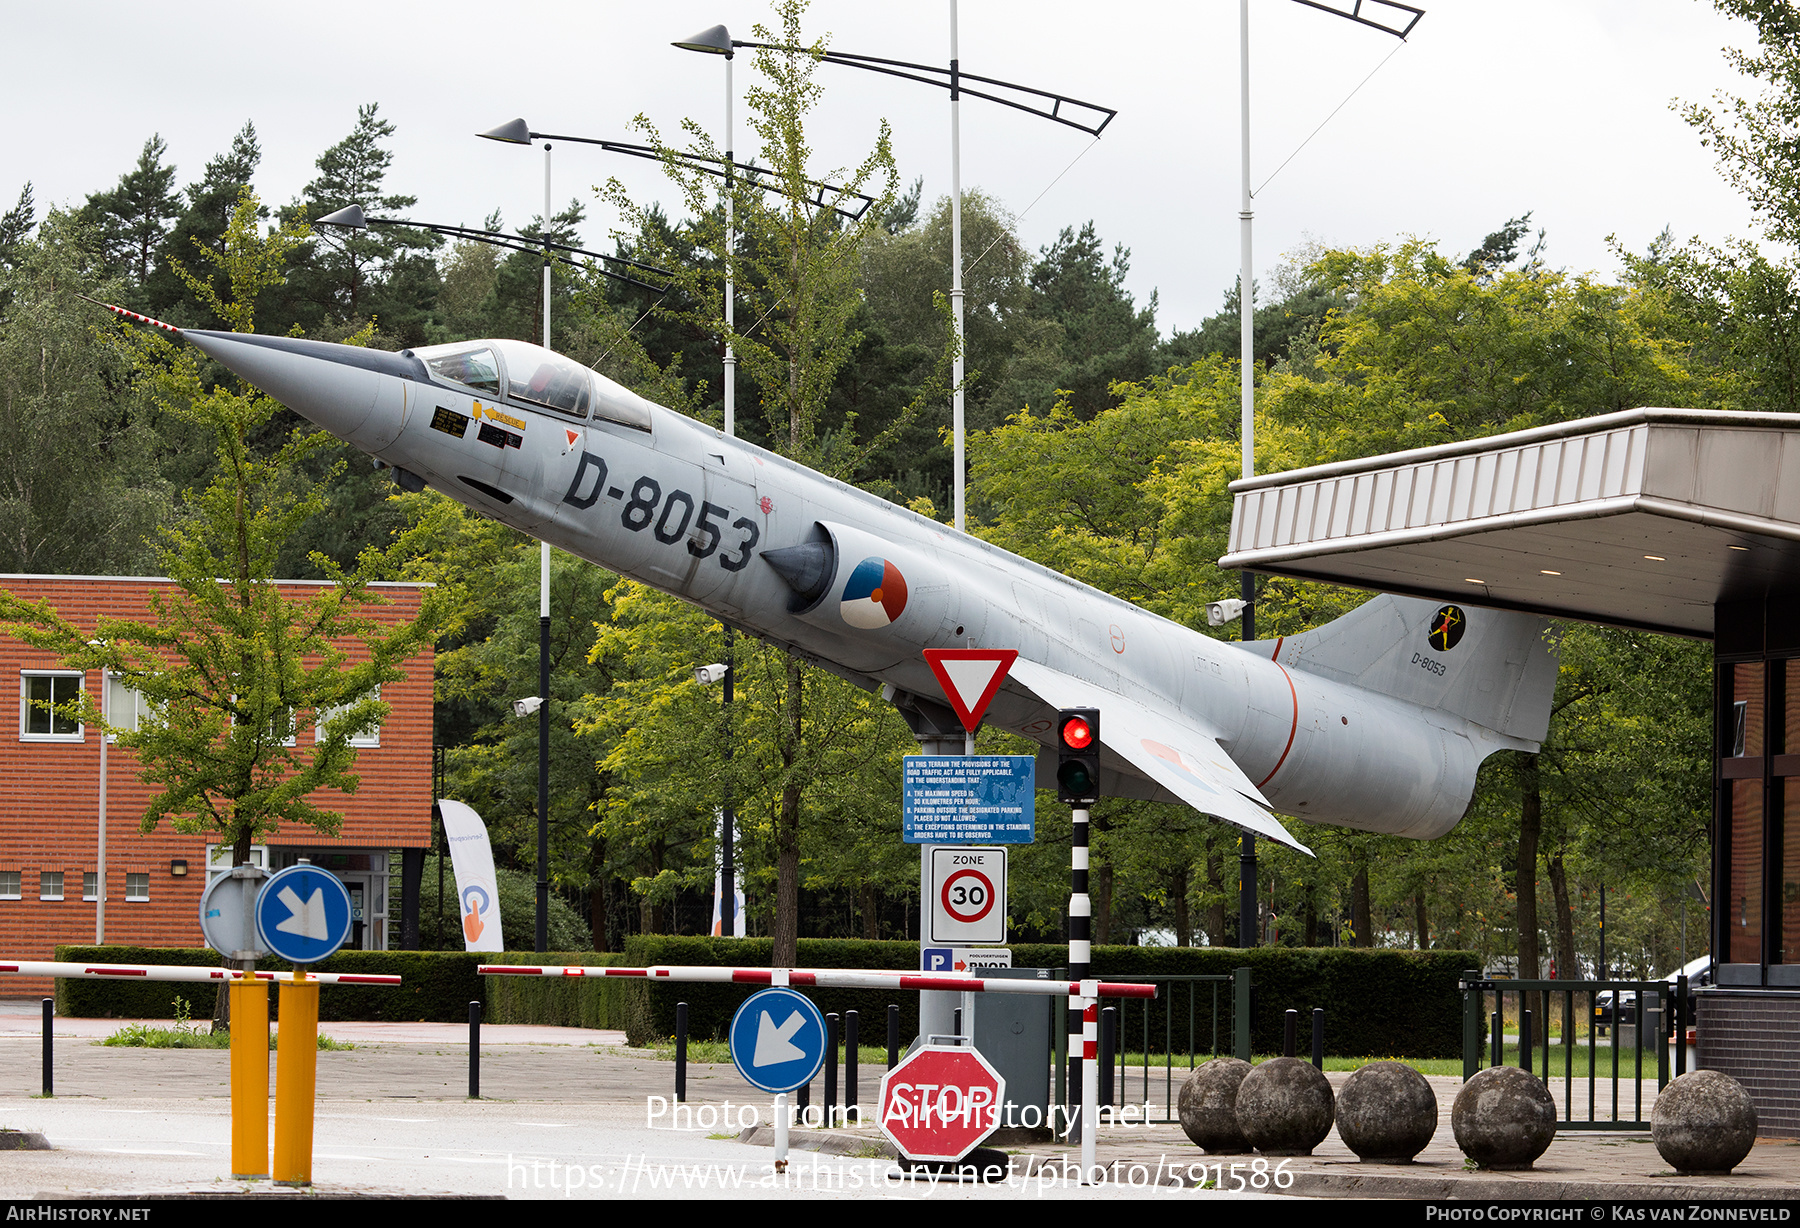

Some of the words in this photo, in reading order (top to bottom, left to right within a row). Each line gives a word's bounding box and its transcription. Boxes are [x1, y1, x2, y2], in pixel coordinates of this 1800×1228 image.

[496, 412, 520, 426] RESCUE
[563, 451, 760, 572] D-8053
[1411, 652, 1446, 676] D-8053
[952, 856, 984, 864] ZONE
[952, 886, 984, 905] 30
[891, 1082, 993, 1123] STOP
